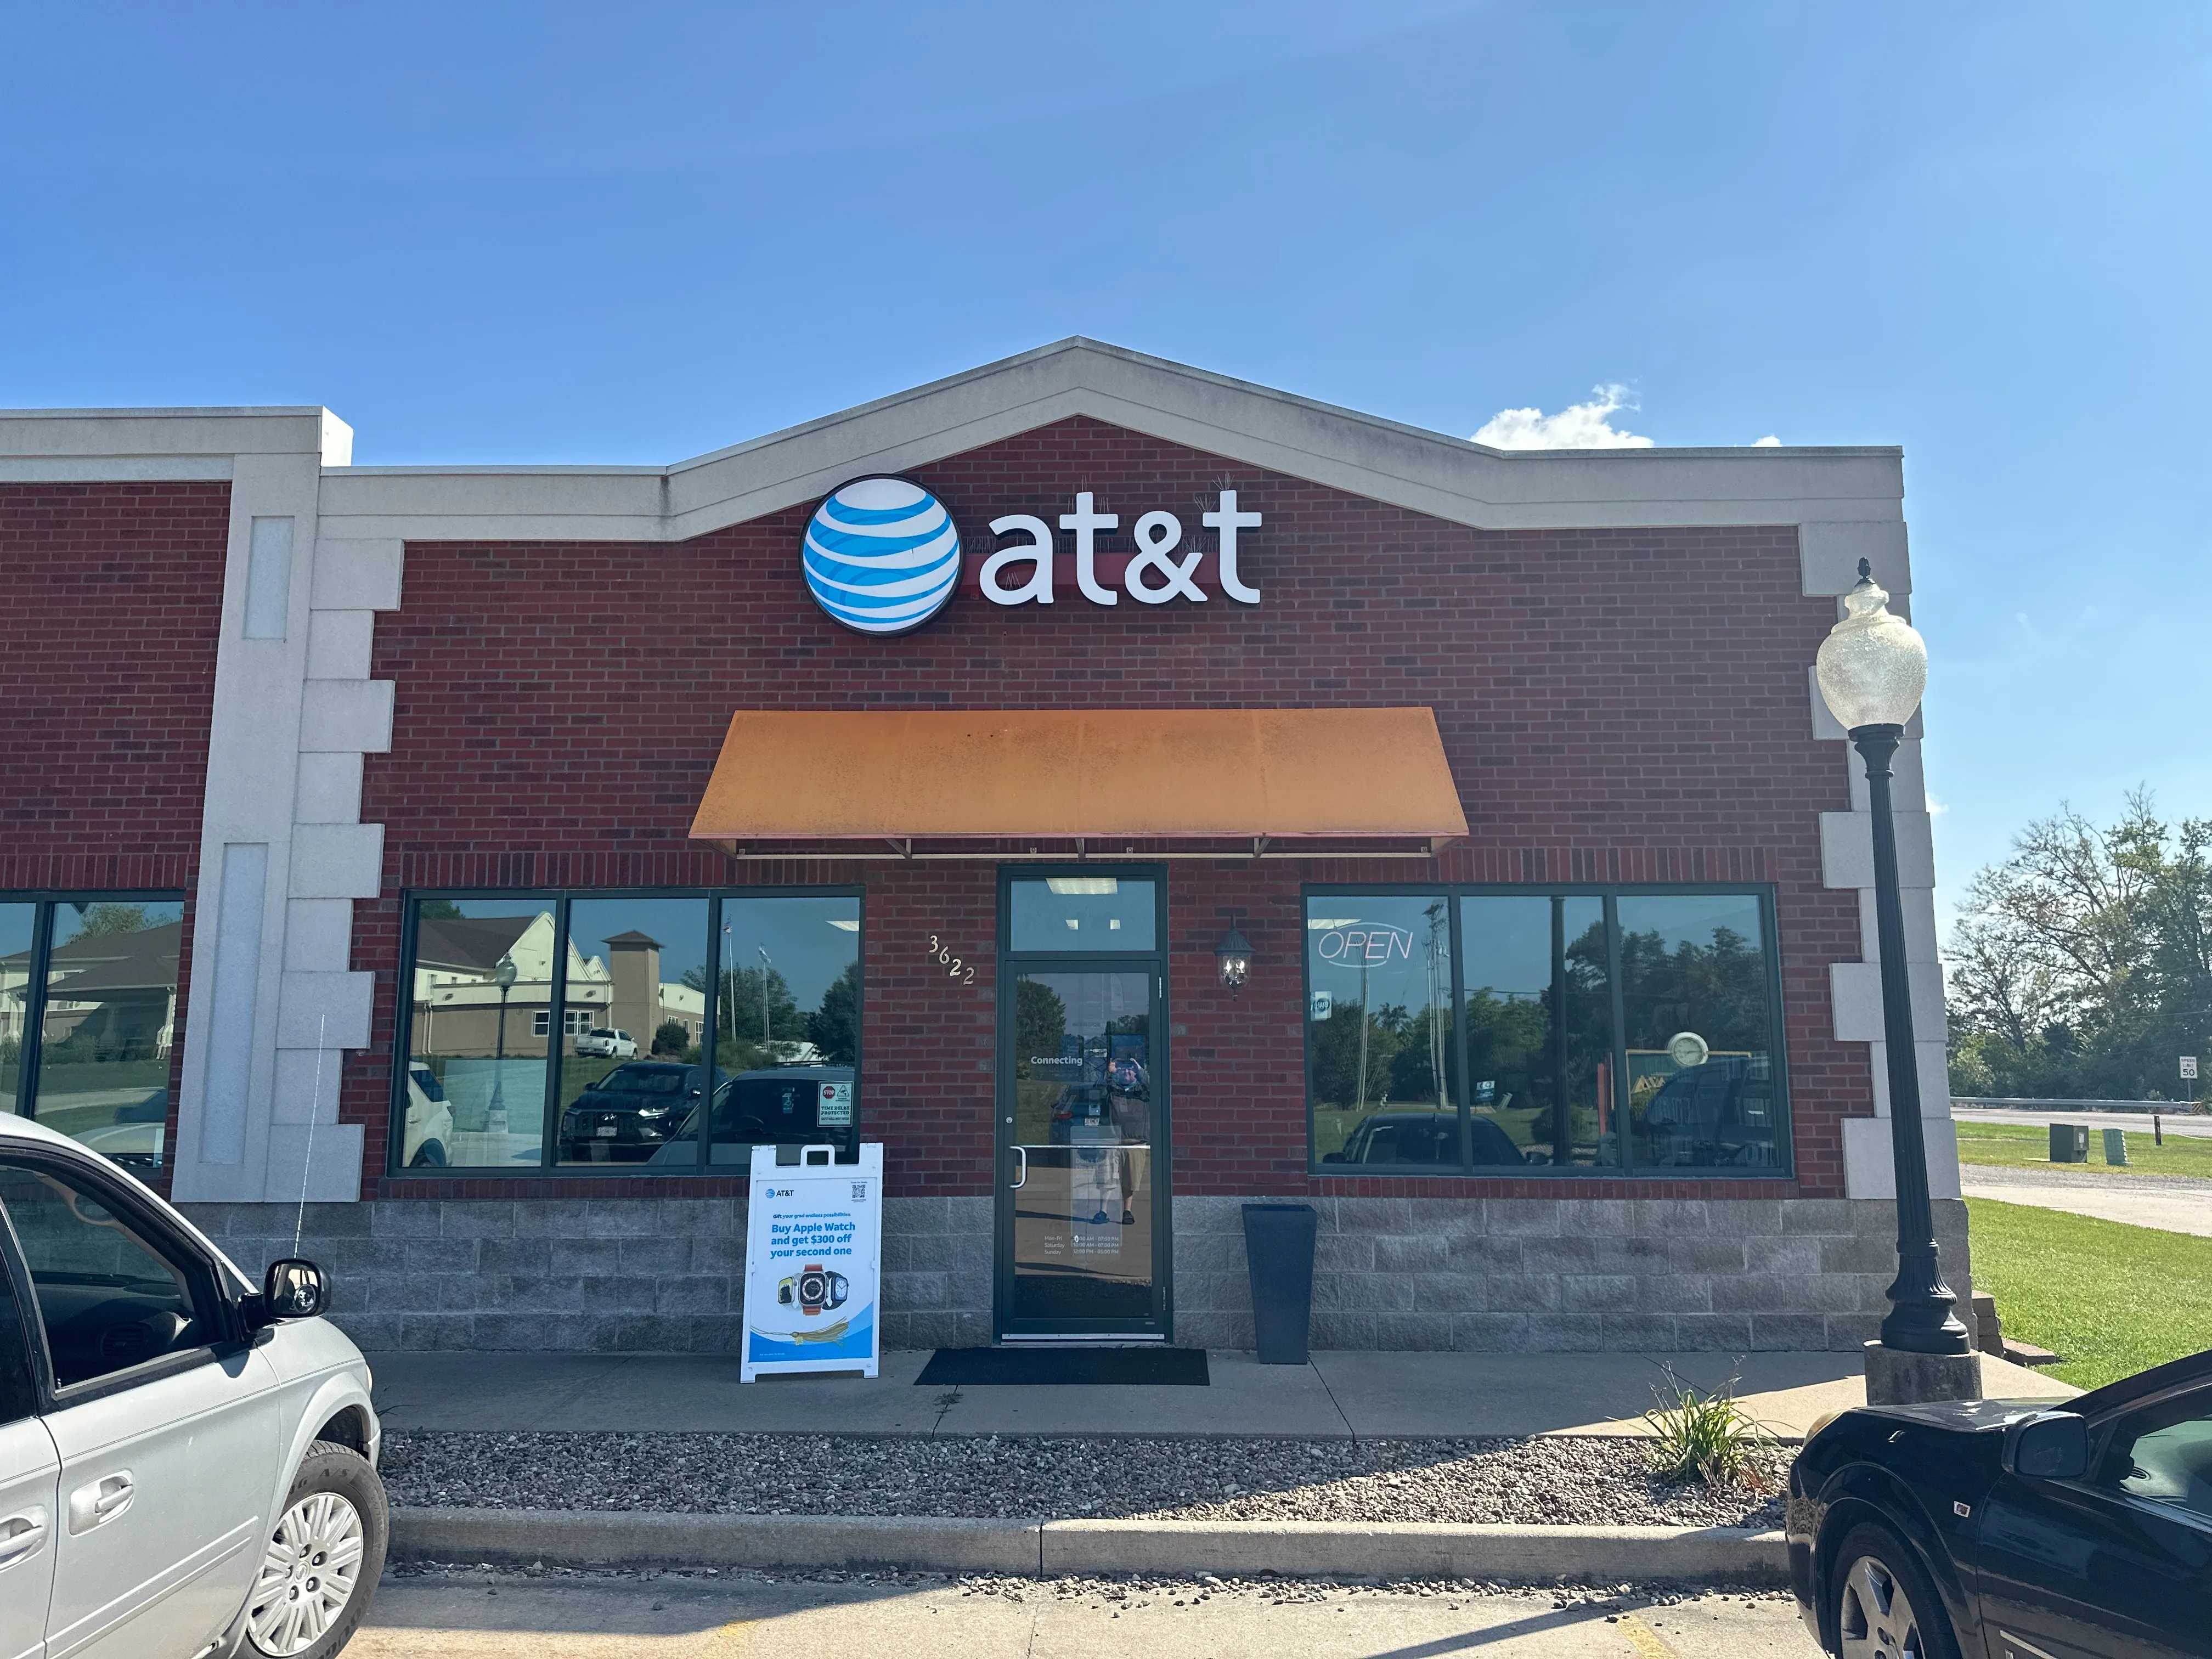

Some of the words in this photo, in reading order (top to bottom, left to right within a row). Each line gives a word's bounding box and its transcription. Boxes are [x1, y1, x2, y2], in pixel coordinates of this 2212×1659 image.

[979, 489, 1262, 606] at&t
[1318, 931, 1414, 960] OPEN
[929, 935, 974, 985] 3622
[1031, 1056, 1083, 1066] Connecting
[771, 1224, 792, 1234] Buy
[793, 1223, 822, 1234] Apple
[825, 1222, 855, 1231] Watch
[771, 1235, 789, 1245] and
[792, 1235, 809, 1246] get
[811, 1234, 834, 1245] $300
[837, 1233, 852, 1243] off
[770, 1249, 794, 1259] your
[795, 1246, 831, 1256] second
[318, 1468, 351, 1479] A/S
